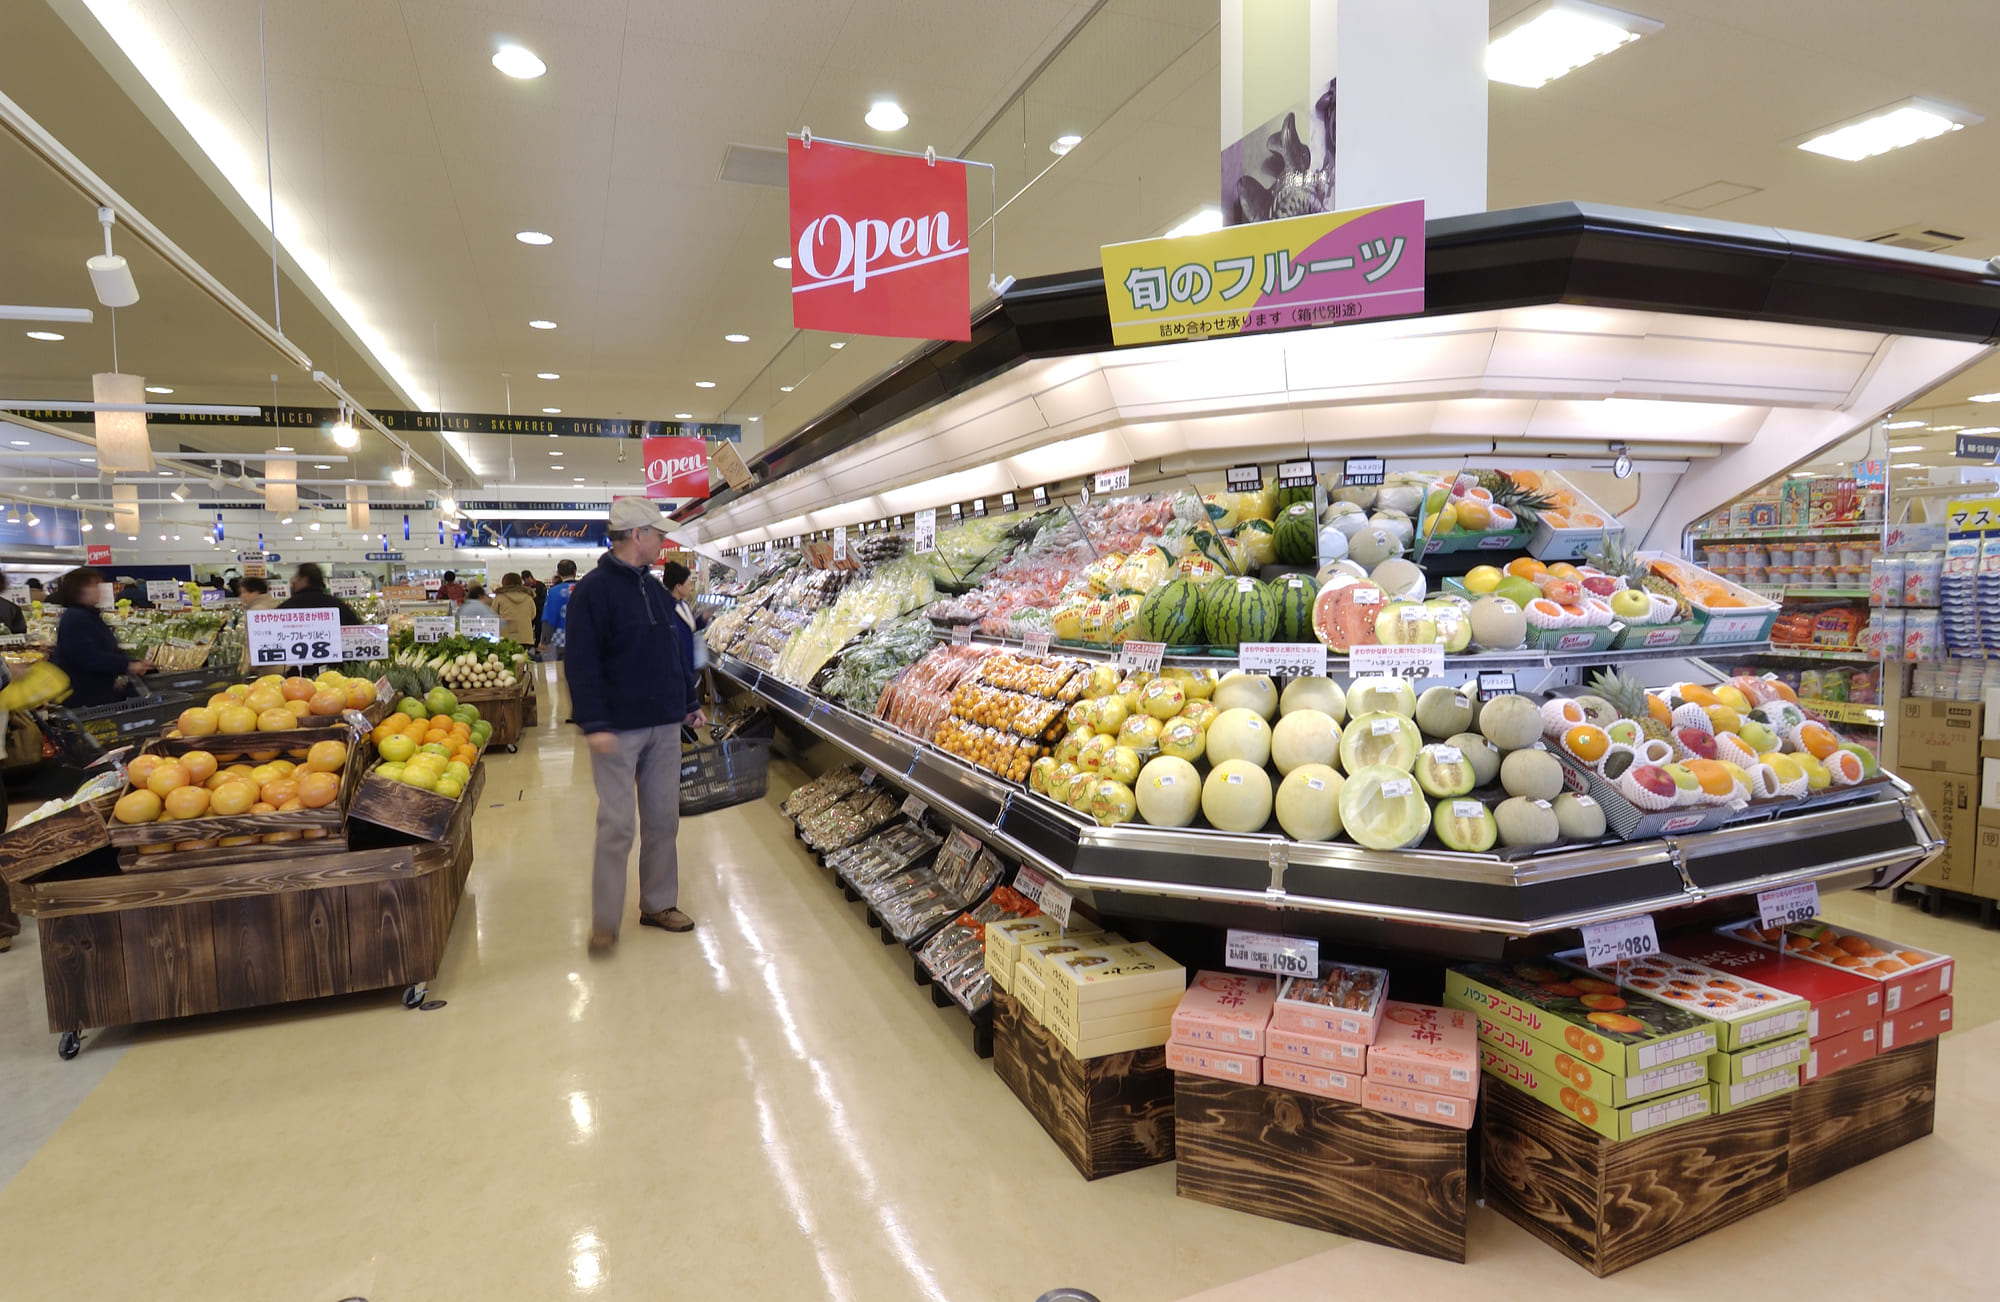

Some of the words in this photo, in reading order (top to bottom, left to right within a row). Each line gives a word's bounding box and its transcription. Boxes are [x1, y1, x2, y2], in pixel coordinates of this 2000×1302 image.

[798, 211, 961, 293] Open
[1124, 236, 1407, 311] 旬のフルーツ
[1160, 312, 1283, 337] 詰め合わせ承ります
[264, 411, 313, 424] SLICED
[416, 417, 469, 429] GRILLED
[491, 419, 554, 432] SKEWERED
[648, 453, 706, 485] Open
[526, 521, 589, 543] Seafood
[291, 642, 331, 659] 98
[355, 646, 381, 656] 298
[1276, 666, 1315, 676] 298
[1391, 666, 1430, 678] 149
[1787, 905, 1815, 921] 980
[1590, 942, 1625, 957] アンコール
[1624, 935, 1651, 955] 980
[1272, 953, 1308, 972] 1980
